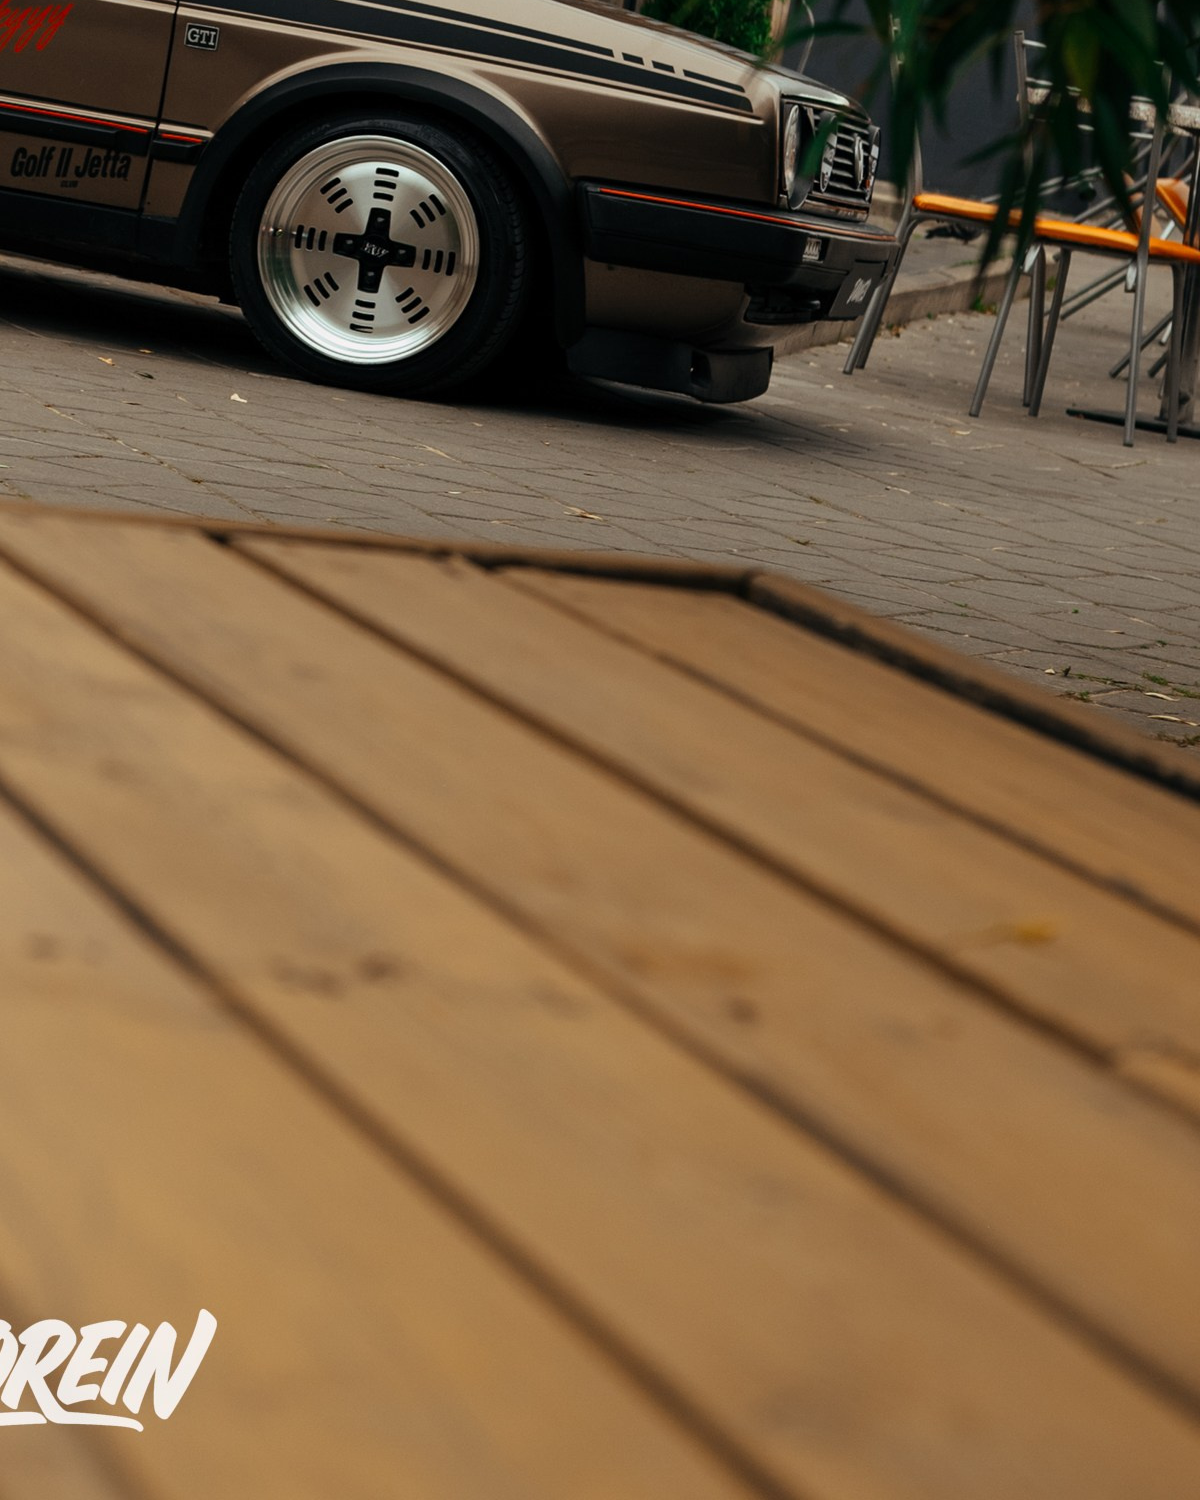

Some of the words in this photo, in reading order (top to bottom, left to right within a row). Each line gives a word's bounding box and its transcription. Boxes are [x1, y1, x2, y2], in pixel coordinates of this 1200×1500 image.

[187, 27, 217, 46] GTI
[10, 146, 56, 178] Golf
[75, 147, 132, 181] Jetta
